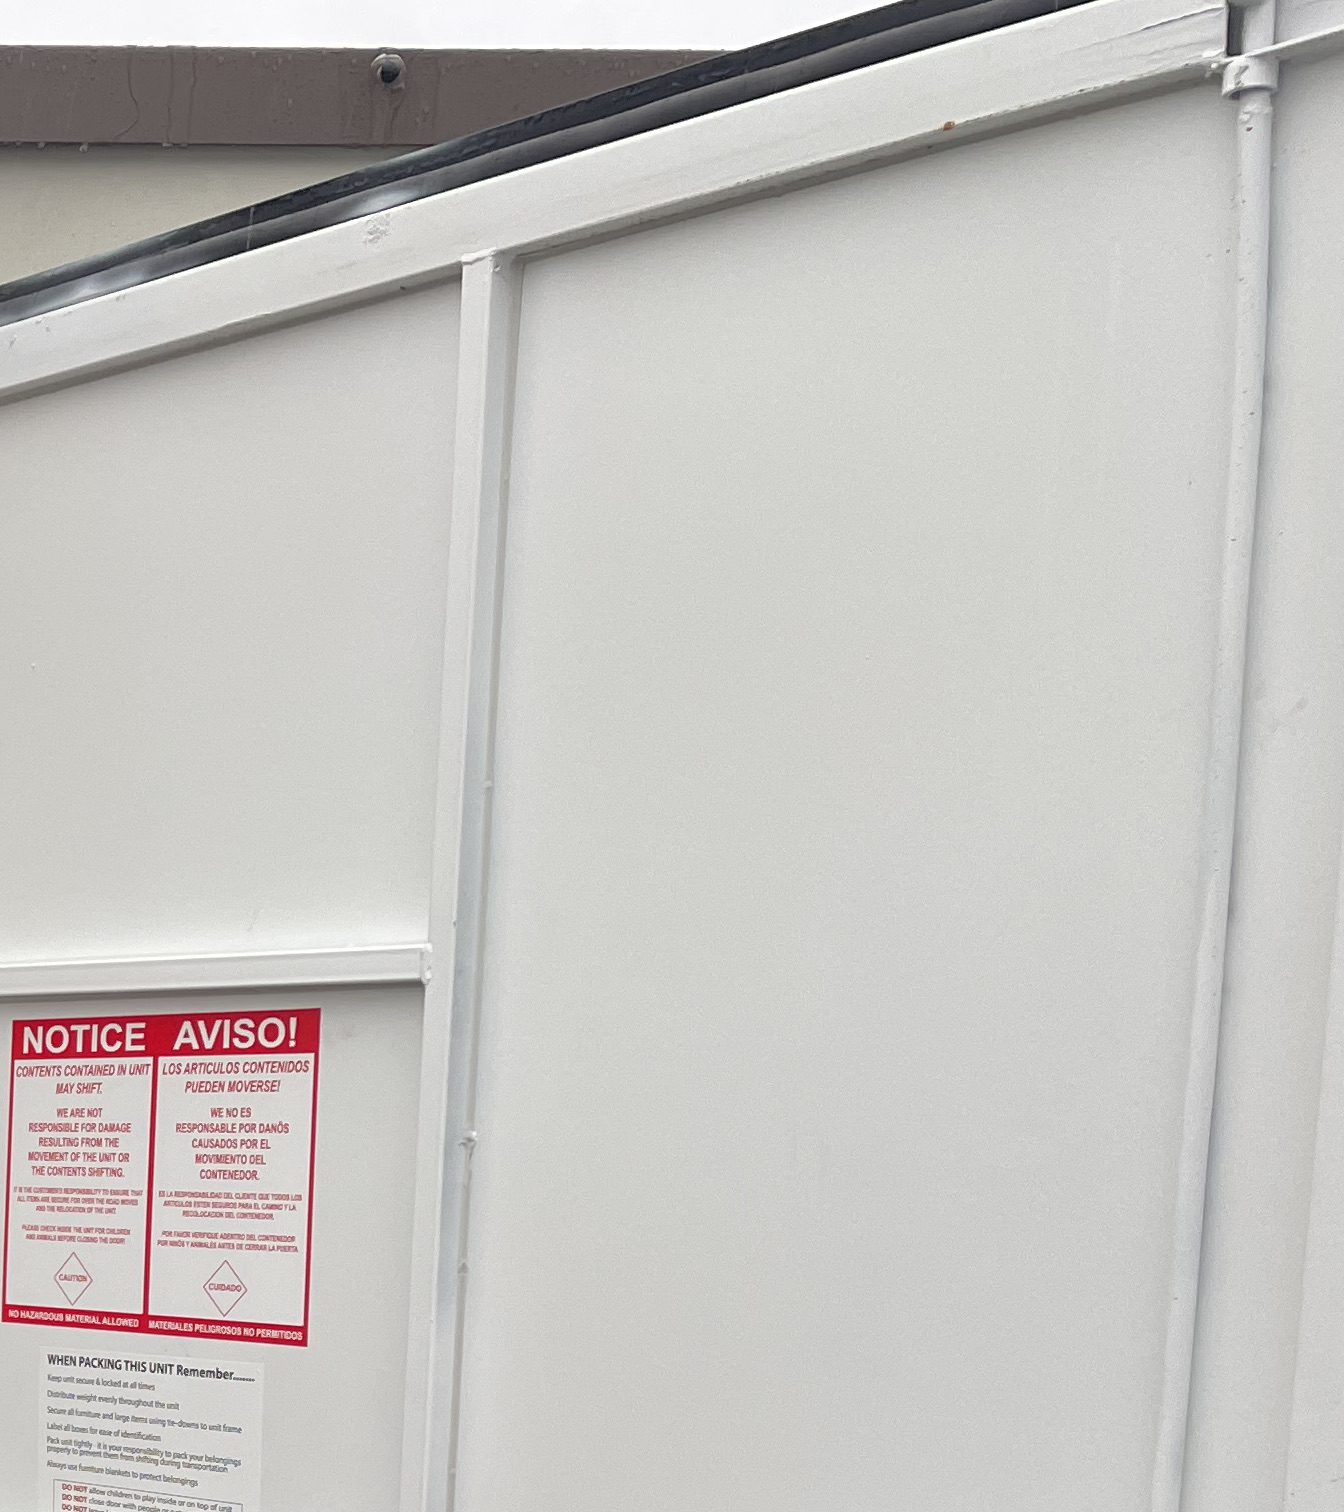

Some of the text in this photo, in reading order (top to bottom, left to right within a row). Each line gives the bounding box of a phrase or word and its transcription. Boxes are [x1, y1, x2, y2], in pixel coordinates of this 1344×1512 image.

[22, 1022, 147, 1054] NOTICE
[173, 1016, 297, 1050] AVISO!
[16, 1063, 151, 1077] CONTENTS CONTAINED IN UNIT
[162, 1060, 310, 1075] LOS ARTICULOS CONTENIDOS
[56, 1082, 103, 1094] MAY SHIFT.
[185, 1080, 281, 1093] PUEDEN MOVERSE!
[57, 1108, 103, 1117] WE ARE NOT
[211, 1107, 251, 1118] WE NO ES
[28, 1123, 131, 1133] RESPONSIBLE FOR DAMAGE
[176, 1122, 237, 1133] RESPONSABLE
[238, 1123, 256, 1133] POR
[38, 1137, 119, 1148] RESULTING FROM THE
[191, 1138, 271, 1149] CAUSADOS POR EL
[28, 1152, 129, 1162] MOVEMENT OF THE UNIT OR
[195, 1154, 266, 1165] MOVIMIENTO DEL
[31, 1166, 125, 1177] THE CONTENTS SHIFTING.
[200, 1169, 260, 1180] CONTENEDOR.
[58, 1274, 87, 1282] CAUTION
[208, 1283, 242, 1292] CUIDADO
[8, 1309, 139, 1327] NO HAZARDOUS MATERIAL ALLOWED
[148, 1320, 303, 1341] MATERIALES PELIGROSOS NO PERMITIDOS
[47, 1354, 76, 1366] WHEN
[79, 1356, 122, 1370] PACKING
[124, 1360, 147, 1372] THIS
[149, 1362, 174, 1375] UNIT
[62, 1483, 72, 1491] DO
[73, 1485, 88, 1493] NOT
